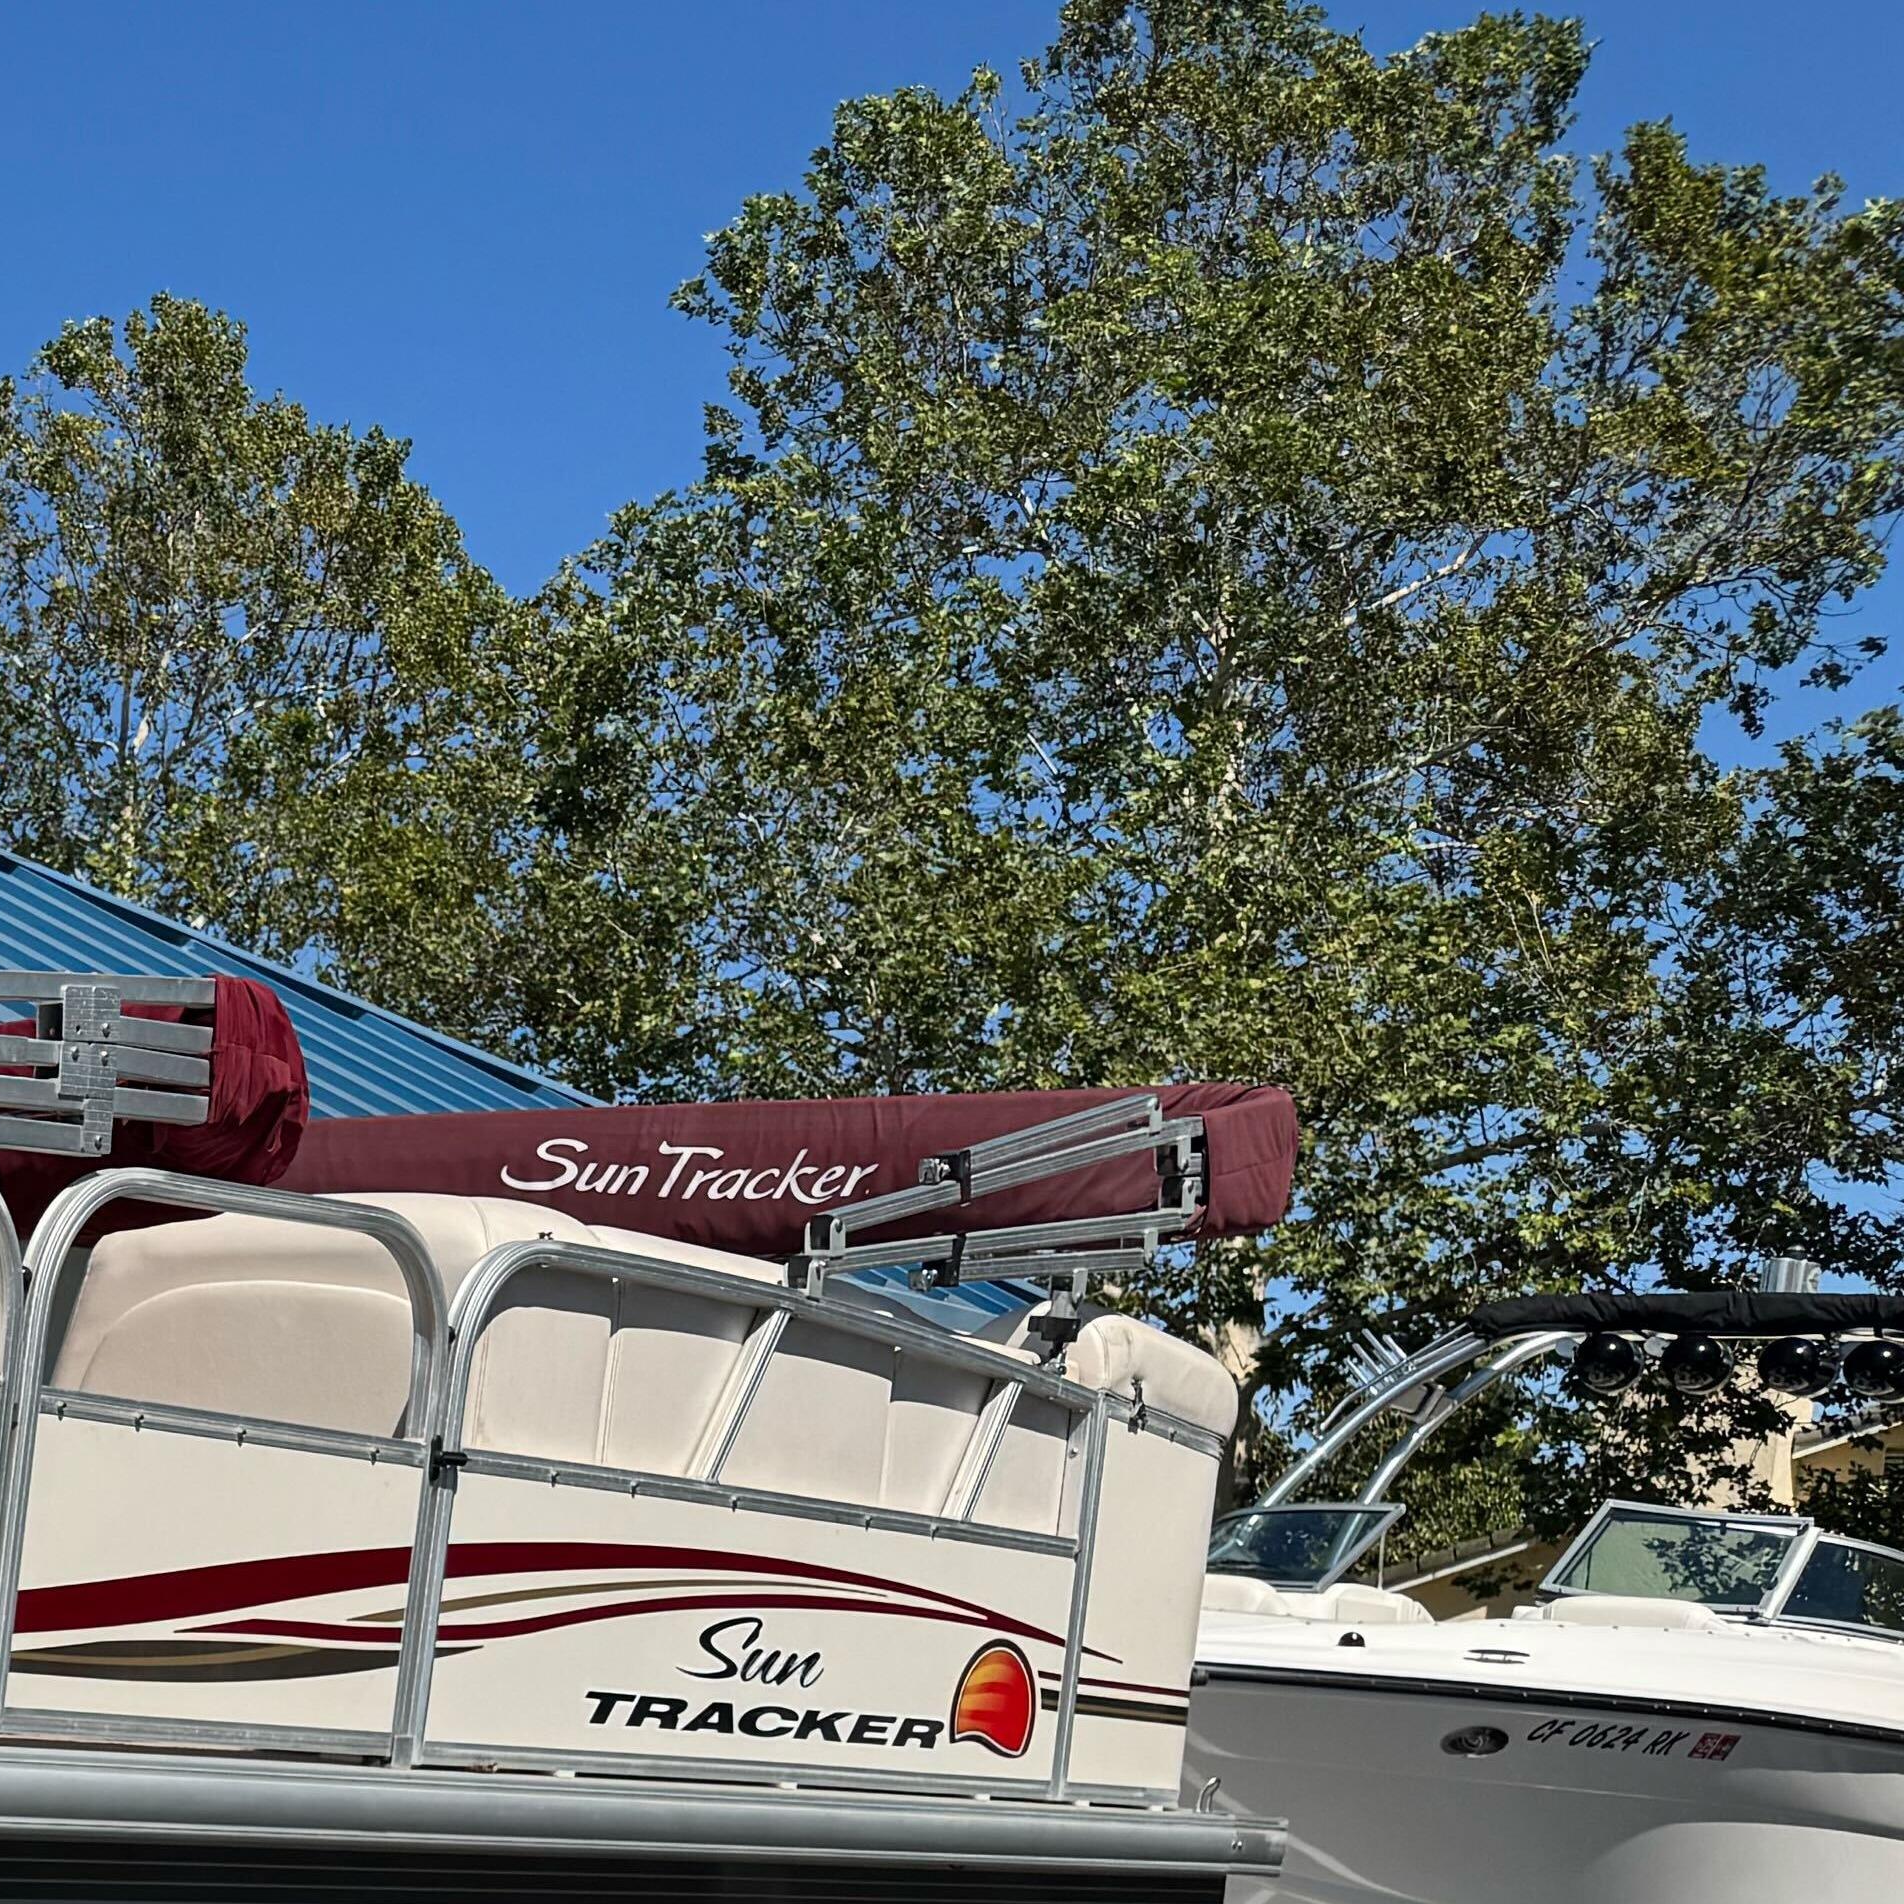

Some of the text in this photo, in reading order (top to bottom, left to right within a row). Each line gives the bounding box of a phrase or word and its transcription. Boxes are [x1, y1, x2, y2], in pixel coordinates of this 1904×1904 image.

[675, 1616, 825, 1689] Sun
[585, 1691, 945, 1750] TRACKER
[1527, 1719, 1576, 1744] CF
[1569, 1722, 1650, 1752] 0624
